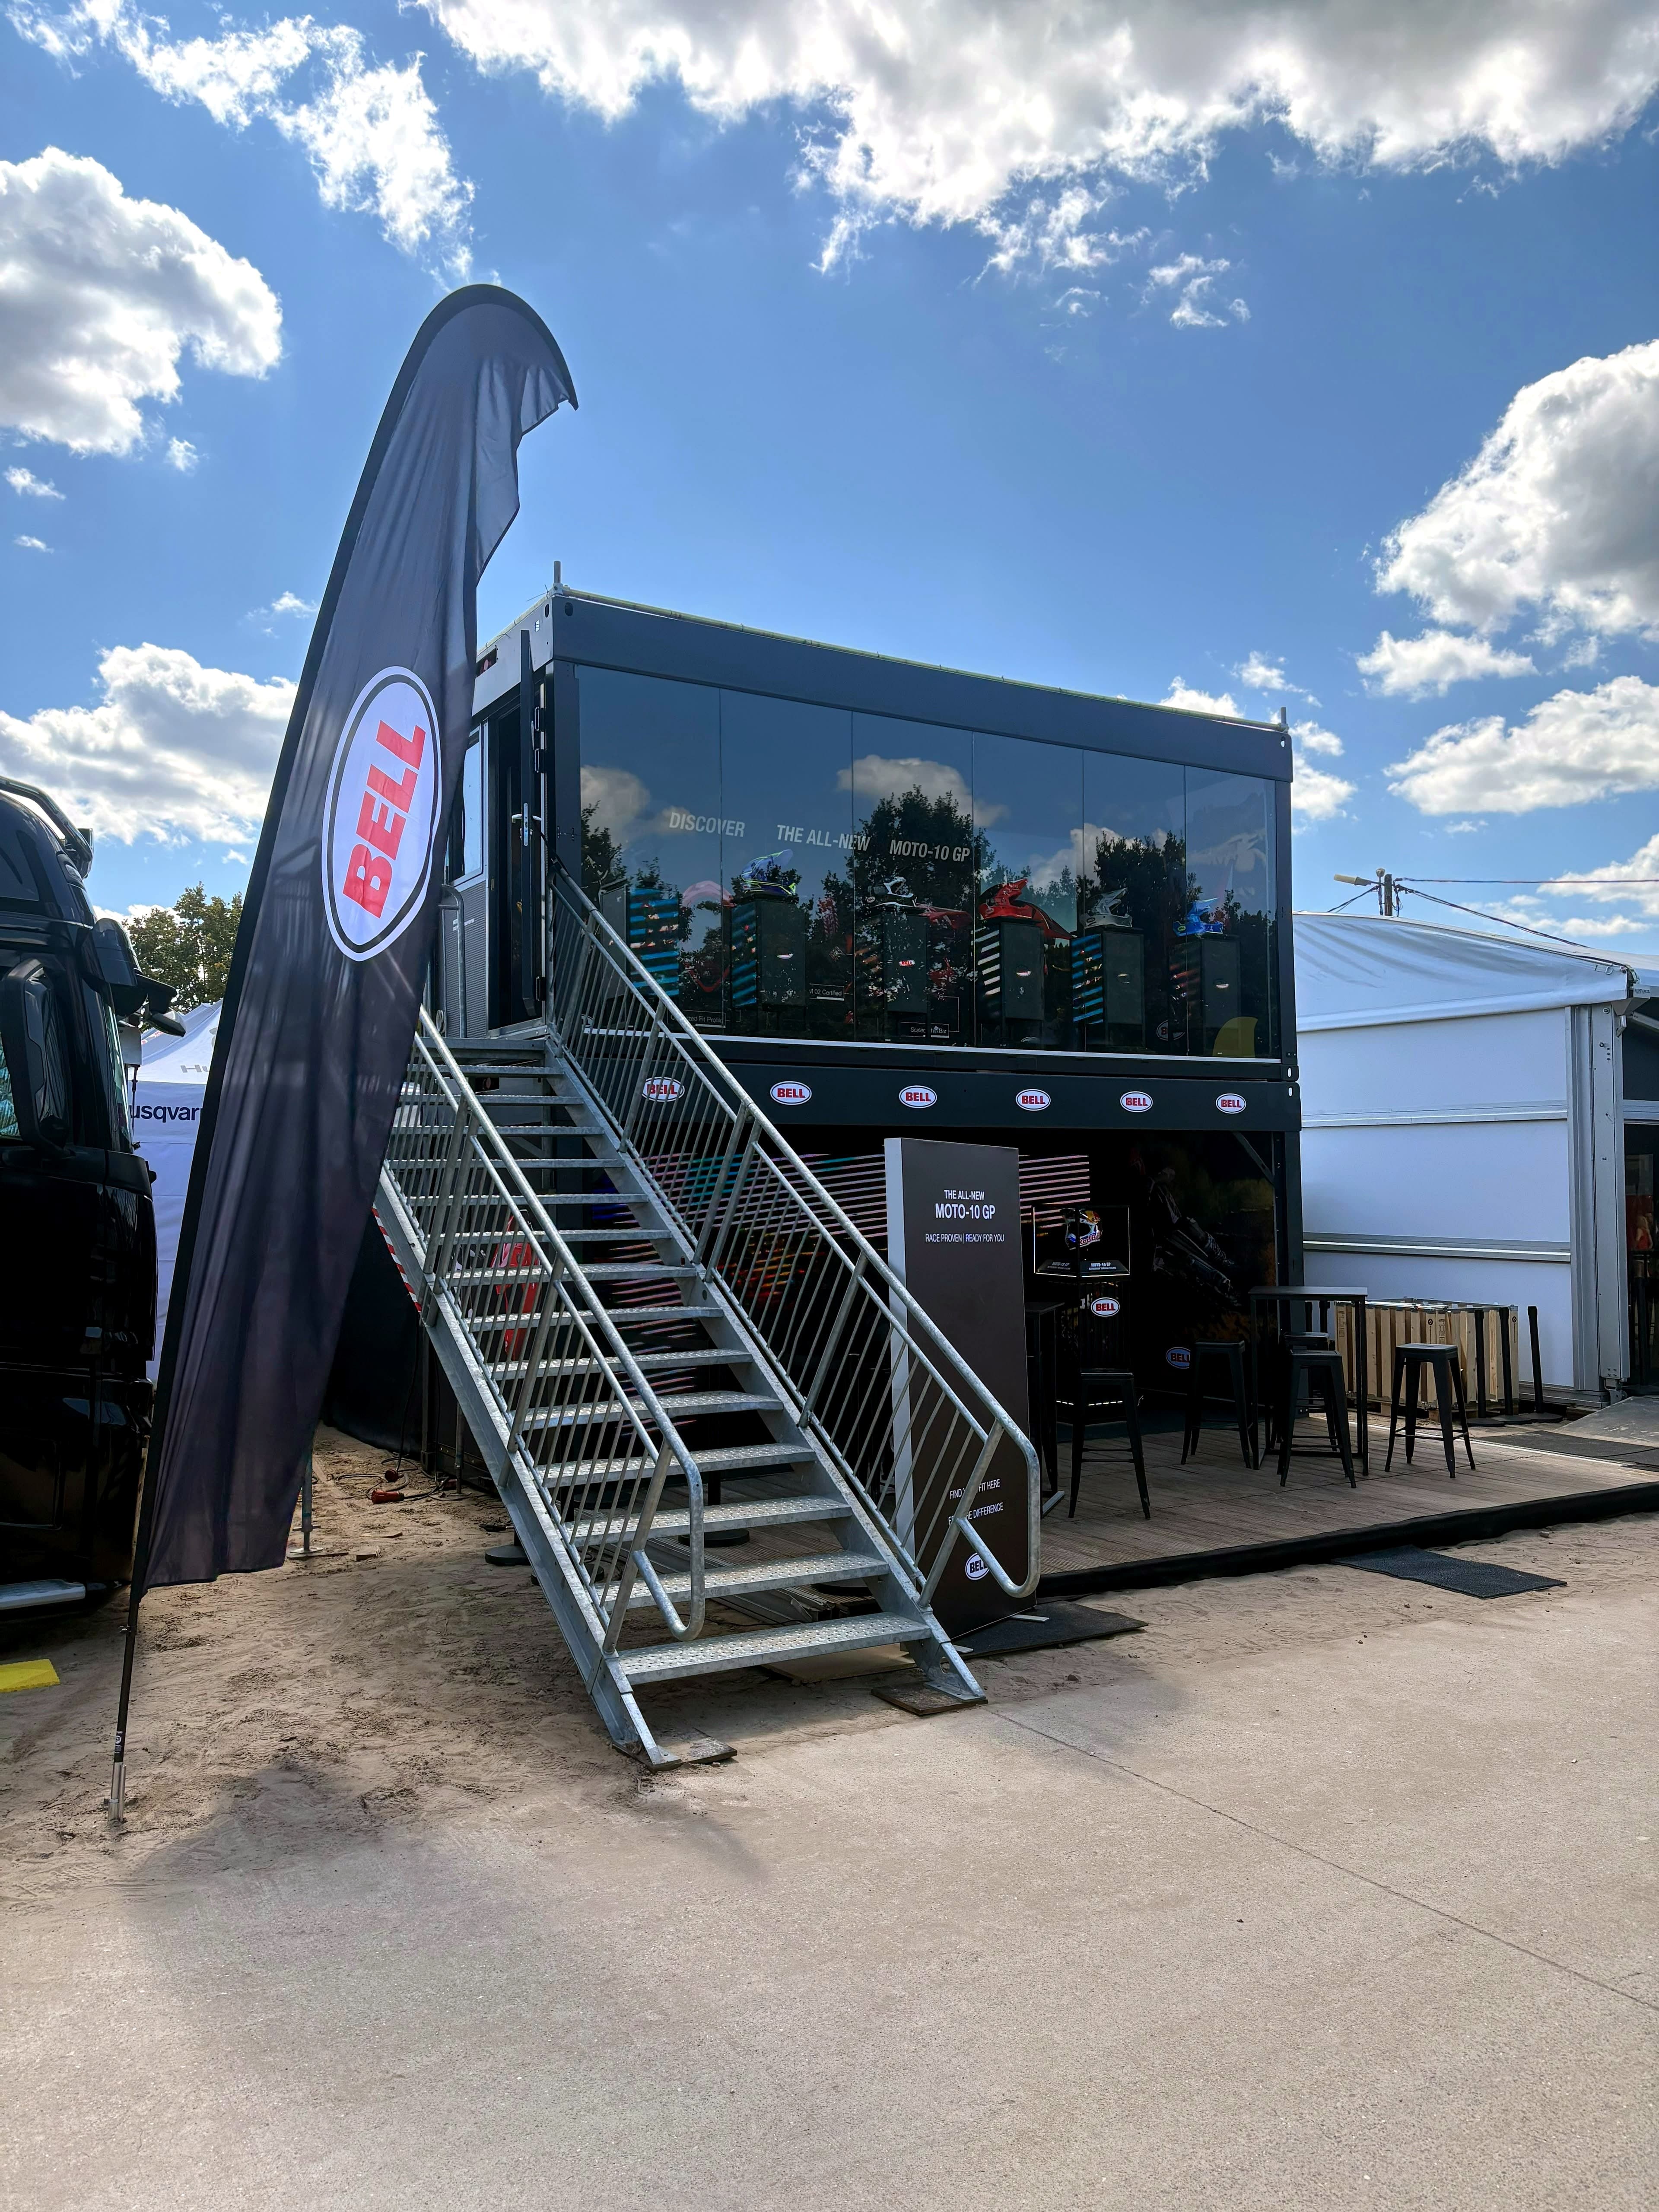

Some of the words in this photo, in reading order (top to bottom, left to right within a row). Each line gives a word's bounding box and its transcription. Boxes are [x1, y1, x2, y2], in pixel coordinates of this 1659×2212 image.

[343, 720, 426, 918] BELL
[669, 812, 745, 837] DISCOVER
[777, 824, 804, 843] THE
[807, 829, 871, 851] ALL-NEW
[889, 839, 949, 860] MOTO-10
[952, 847, 970, 862] GP
[777, 1087, 805, 1099] BELL
[905, 1092, 931, 1103] BELL
[1022, 1095, 1046, 1105] BELL
[1126, 1097, 1148, 1107] BELL
[1221, 1099, 1242, 1108] BELL
[129, 1105, 202, 1123] usqvar
[944, 1190, 957, 1199] THE
[958, 1190, 985, 1200] ALL-NEW
[935, 1203, 980, 1219] MOTO-10
[982, 1205, 995, 1219] GP
[925, 1233, 940, 1242] RACE
[941, 1233, 962, 1242] PROVEN
[966, 1234, 982, 1242] READY
[983, 1234, 993, 1242] FOR
[994, 1234, 1004, 1243] YOU
[1096, 1303, 1116, 1311] BELL
[950, 1489, 962, 1500] FIND
[987, 1479, 1000, 1490] HERE
[973, 1502, 1003, 1519] DIFFERENCE
